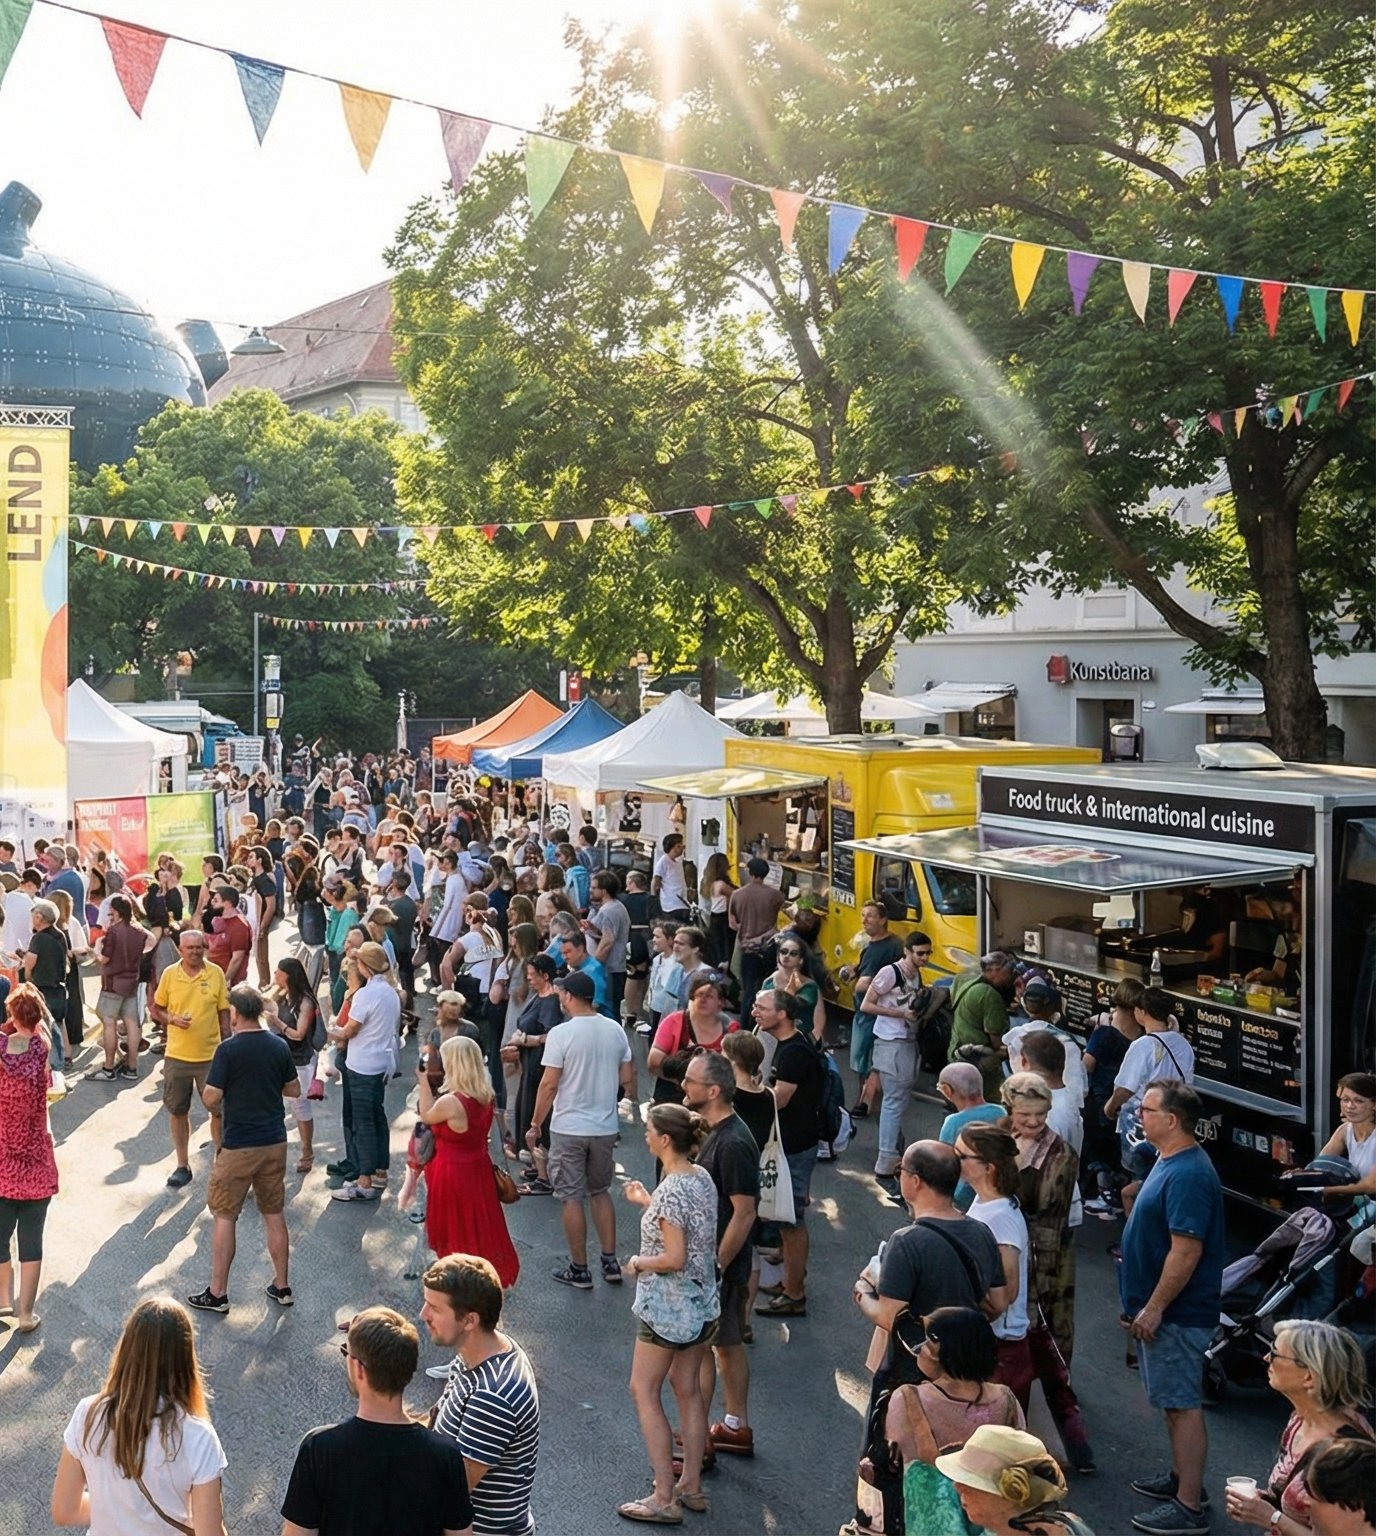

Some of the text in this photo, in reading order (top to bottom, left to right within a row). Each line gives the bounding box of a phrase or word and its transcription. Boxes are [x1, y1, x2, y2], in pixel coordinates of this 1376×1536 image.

[8, 445, 42, 561] LEND
[1008, 787, 1275, 838] Food truck & international cuisine
